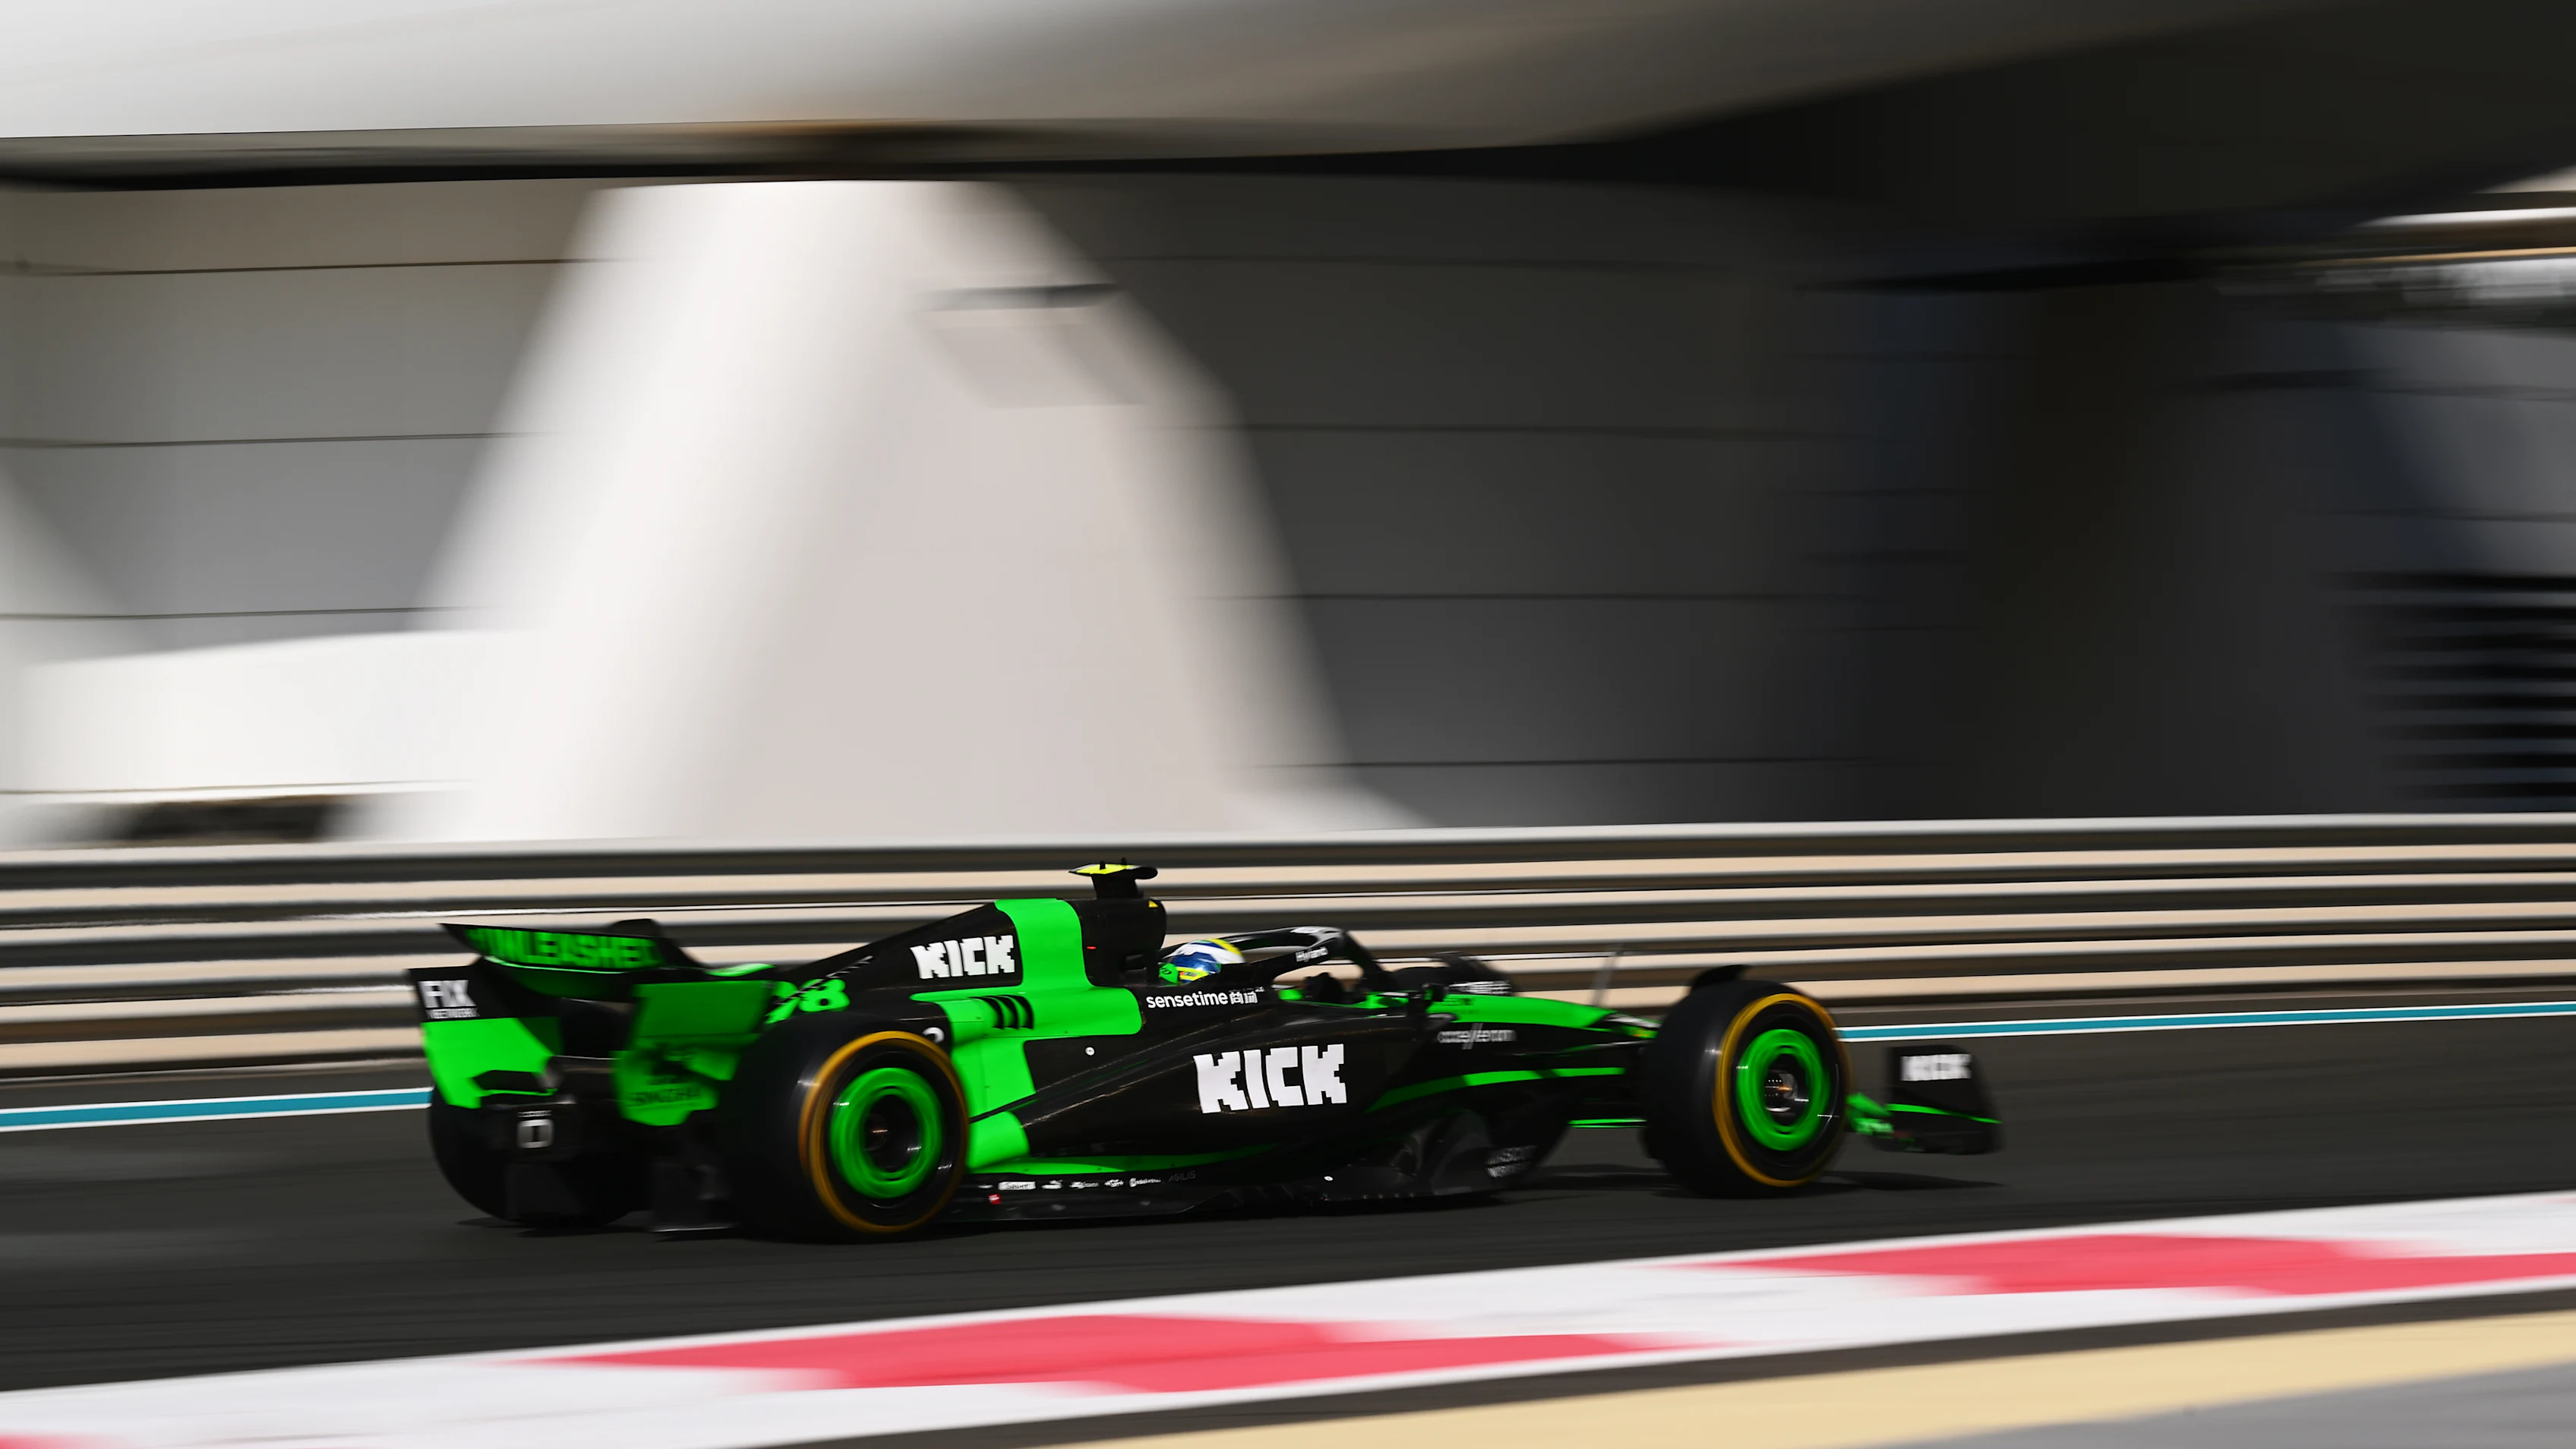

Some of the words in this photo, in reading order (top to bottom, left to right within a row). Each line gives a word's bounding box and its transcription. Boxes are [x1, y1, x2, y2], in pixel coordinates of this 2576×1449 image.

[910, 935, 1015, 979] KICK
[1146, 991, 1227, 1008] sensetime
[1193, 1043, 1347, 1113] KICK
